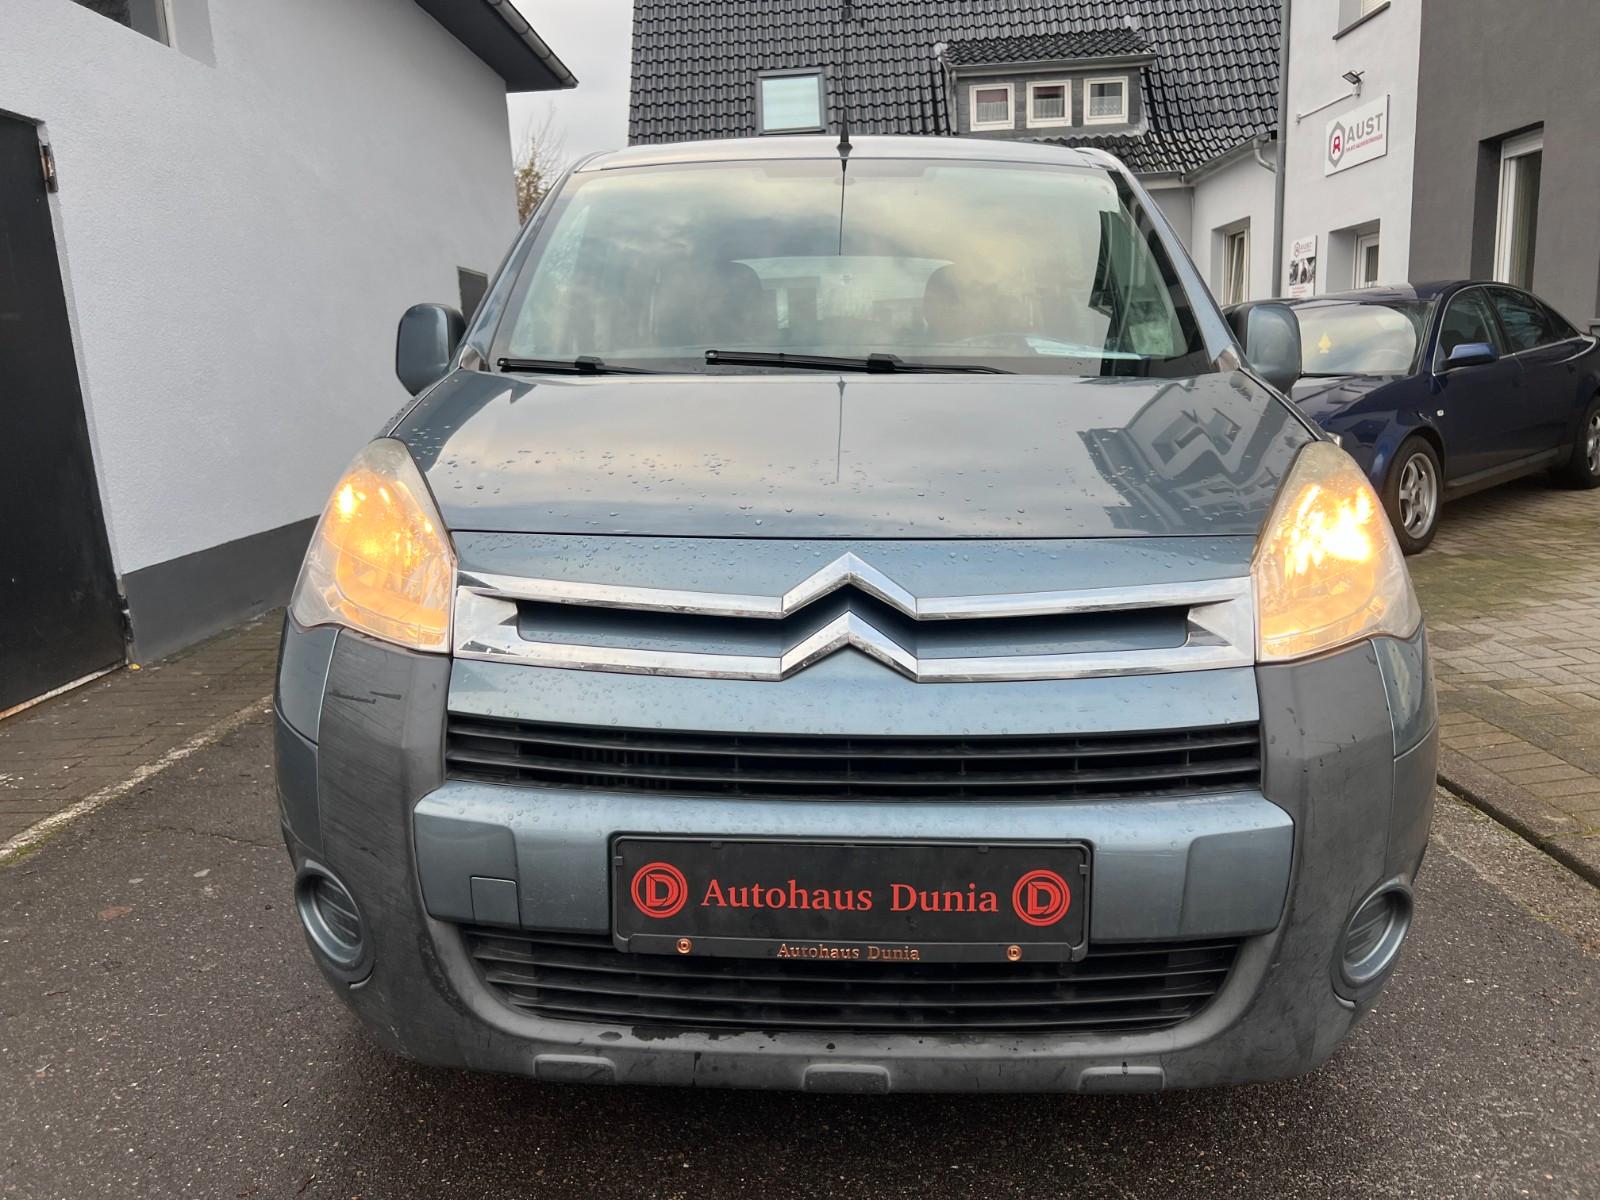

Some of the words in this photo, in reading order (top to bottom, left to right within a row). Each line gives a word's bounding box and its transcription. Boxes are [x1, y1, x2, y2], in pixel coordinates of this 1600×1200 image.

[1346, 112, 1383, 144] AUST
[701, 879, 873, 911] Autohaus
[890, 882, 999, 912] Dunia
[777, 943, 860, 959] Autohaus
[868, 945, 920, 960] Dunia
